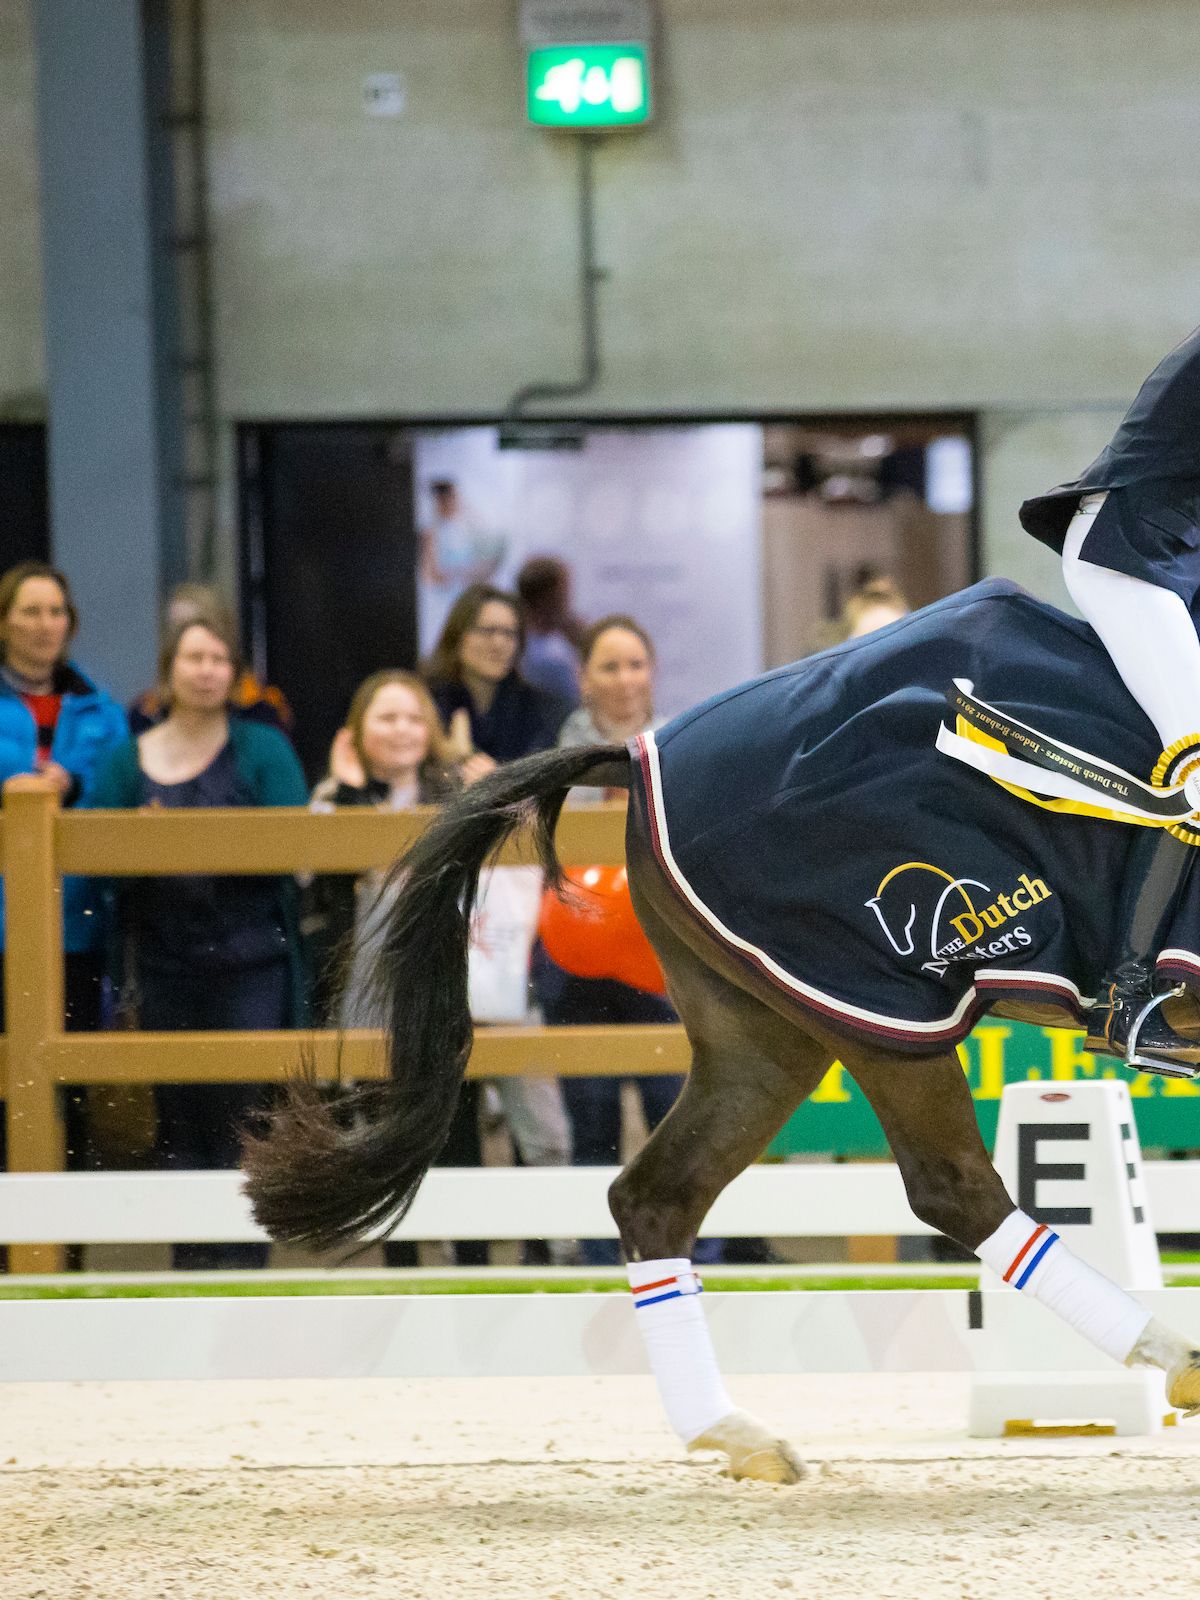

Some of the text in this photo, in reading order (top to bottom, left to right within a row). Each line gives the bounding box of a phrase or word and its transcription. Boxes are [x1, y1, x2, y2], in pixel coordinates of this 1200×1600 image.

[956, 697, 976, 715] 2019
[975, 711, 1010, 736] Brabant
[1010, 731, 1040, 753] Indoor
[1045, 750, 1083, 775] Masters
[1083, 771, 1112, 788] Dutch
[1112, 782, 1129, 797] The
[937, 873, 1053, 957] THE Dutch
[921, 926, 1032, 978] Mters
[1018, 1123, 1091, 1224] E
